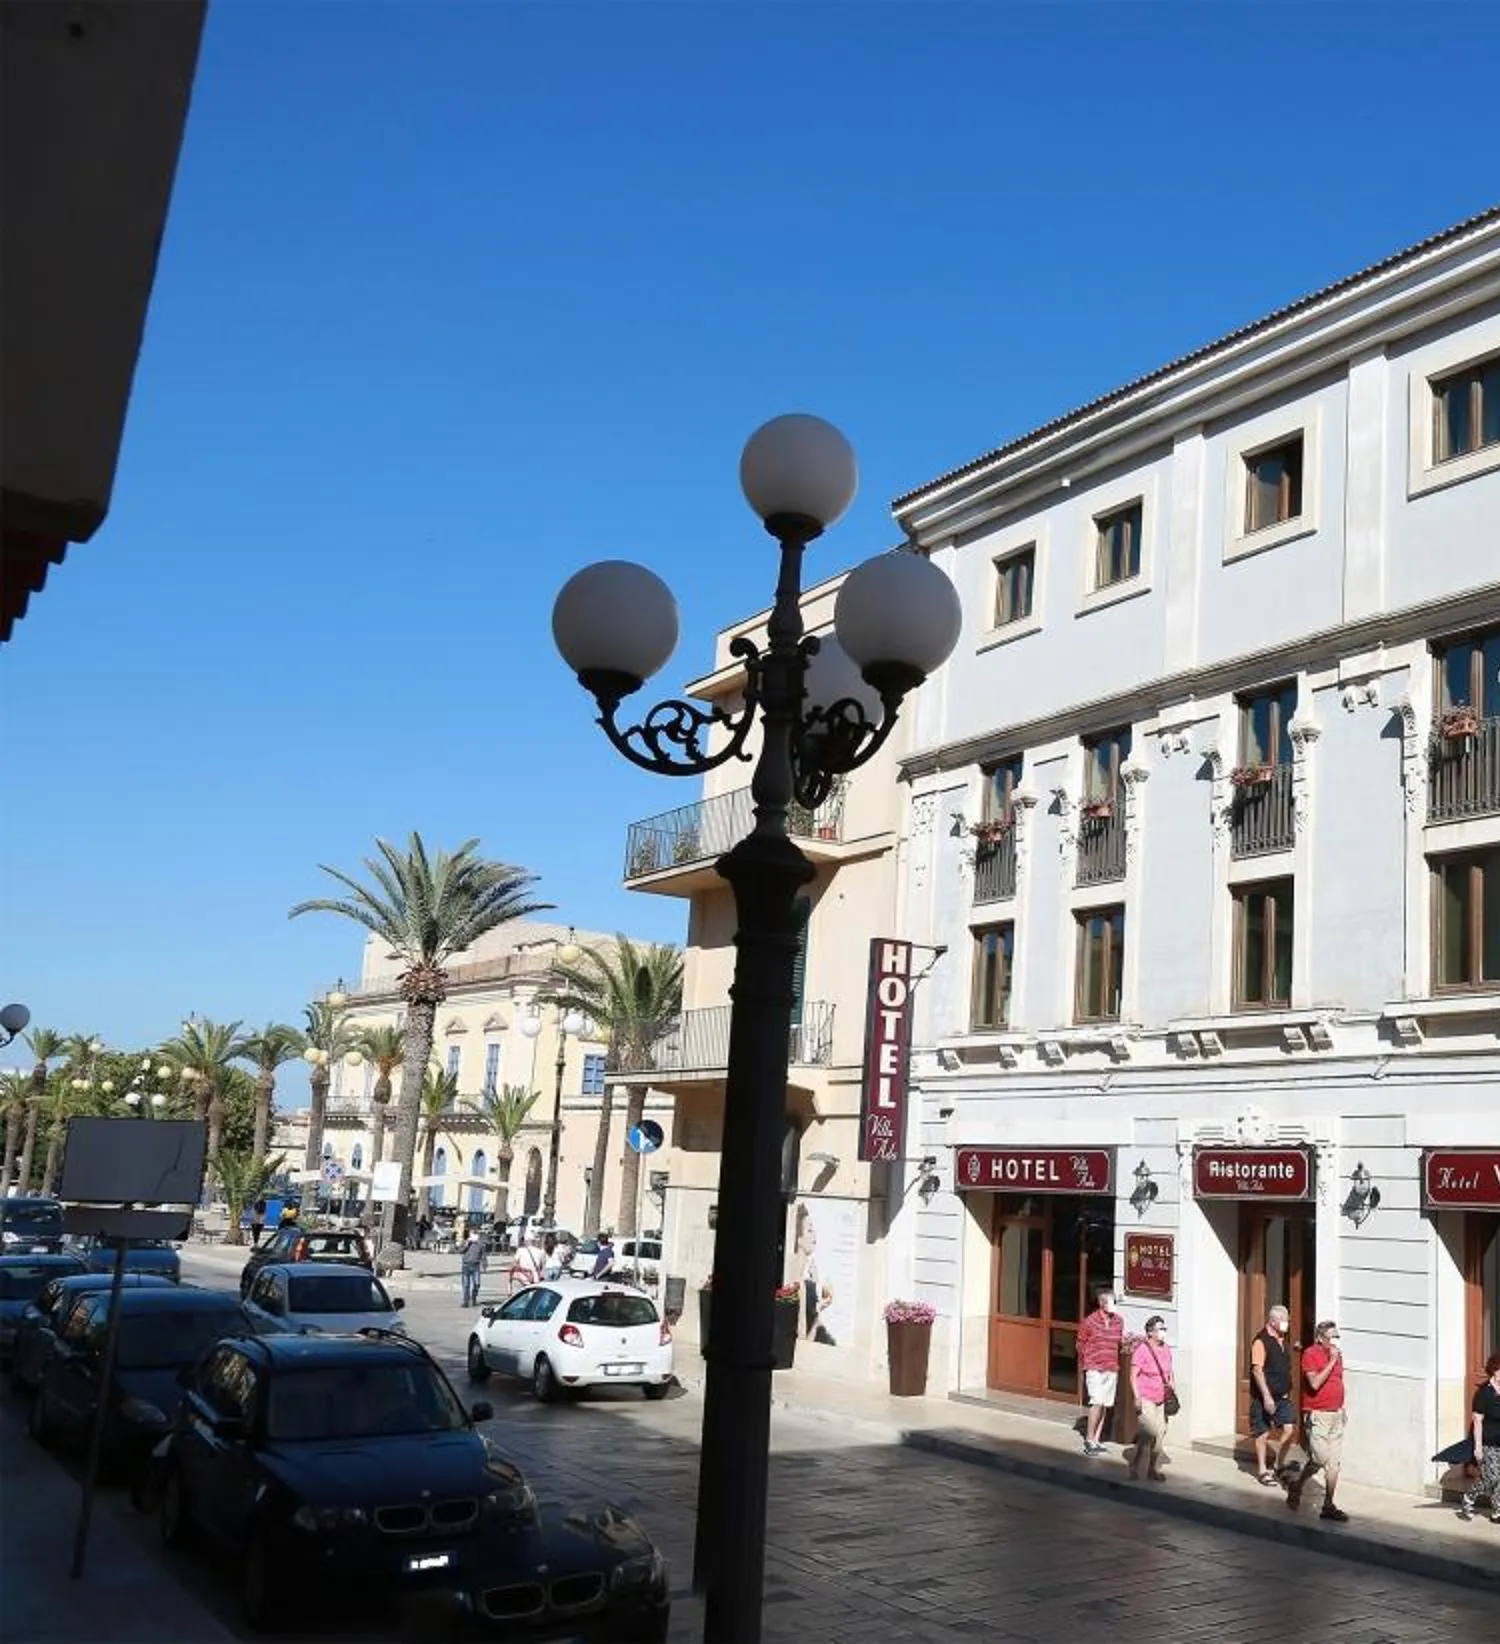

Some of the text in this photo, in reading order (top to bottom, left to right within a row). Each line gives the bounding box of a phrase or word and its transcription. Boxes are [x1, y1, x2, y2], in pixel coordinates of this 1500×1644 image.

[877, 943, 908, 1109] HOTEL
[991, 1158, 1061, 1182] HOTEL
[1208, 1160, 1295, 1179] Ristorante
[1139, 1244, 1171, 1257] HOTEL
